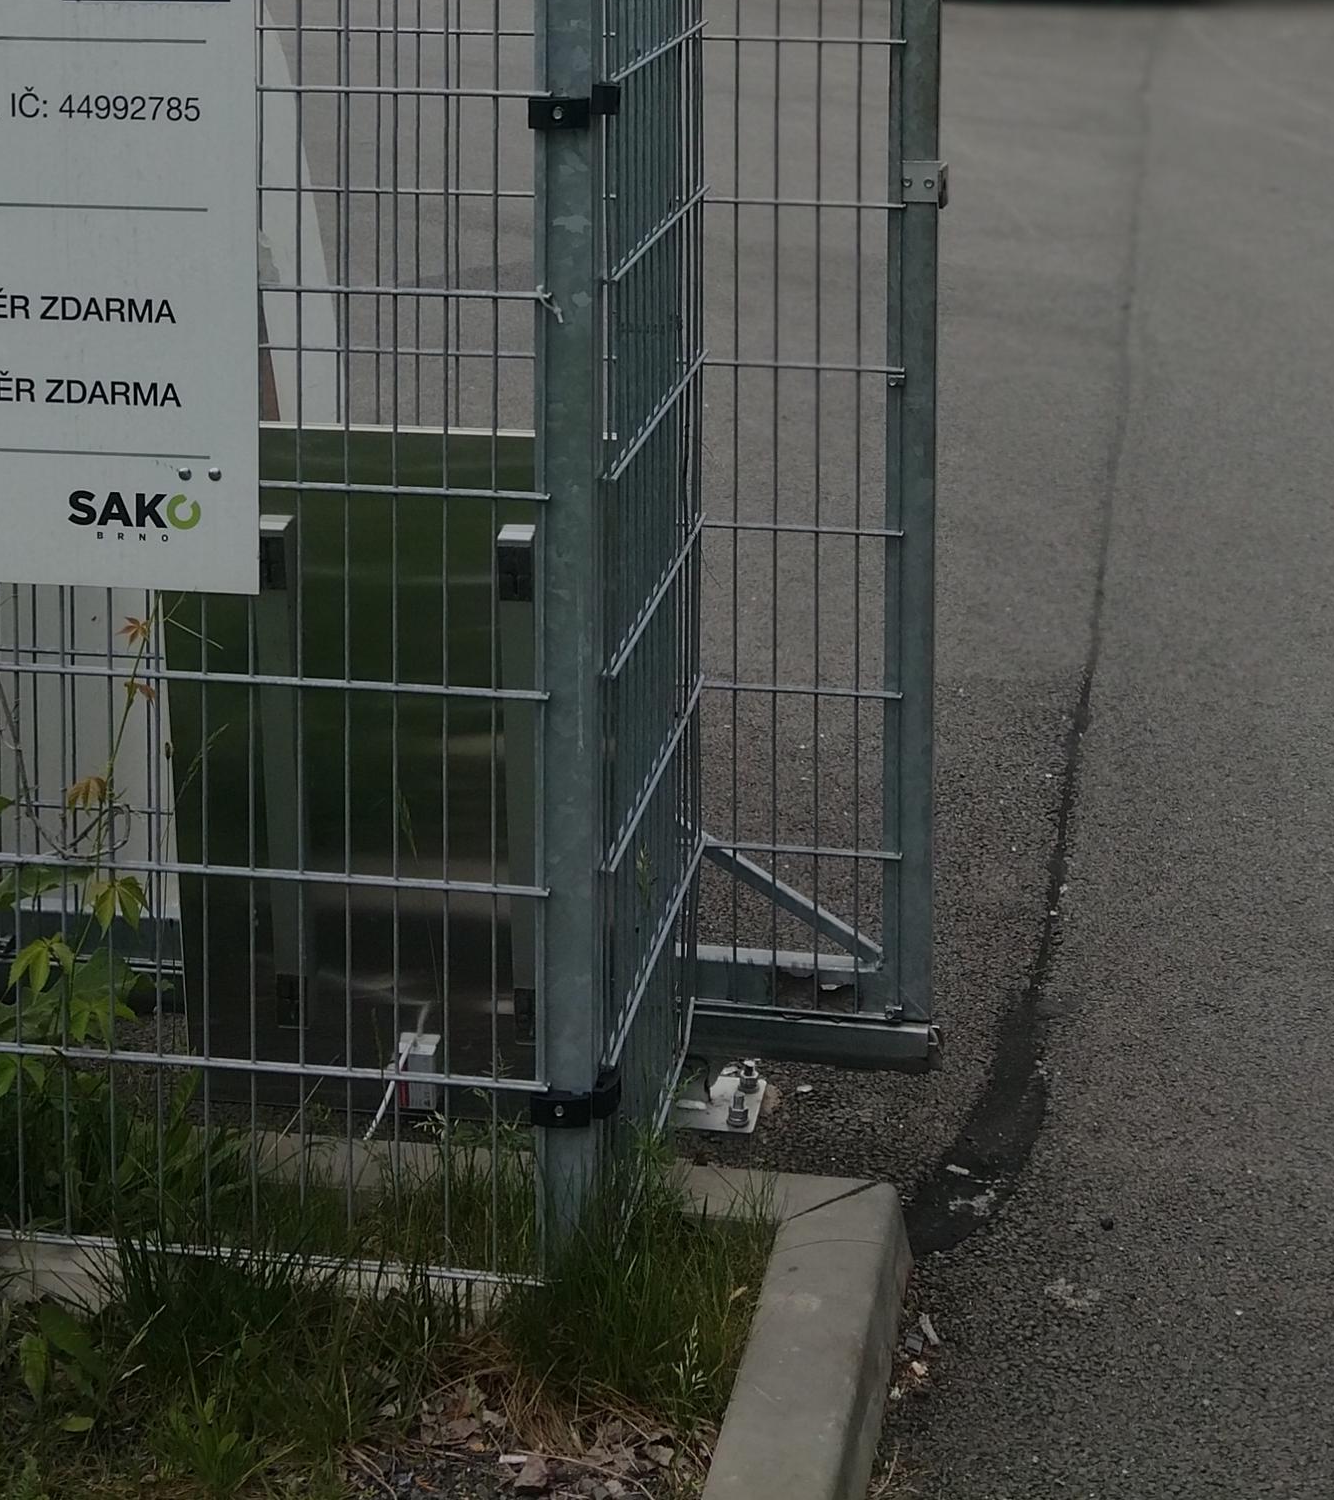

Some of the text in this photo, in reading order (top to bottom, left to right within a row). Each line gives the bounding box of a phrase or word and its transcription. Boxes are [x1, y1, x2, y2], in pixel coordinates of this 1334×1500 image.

[11, 86, 48, 119] IČ:
[58, 94, 201, 122] 44992785
[39, 295, 177, 324] ZDARMA
[45, 378, 182, 408] ZDARMA
[68, 490, 201, 530] SAKO
